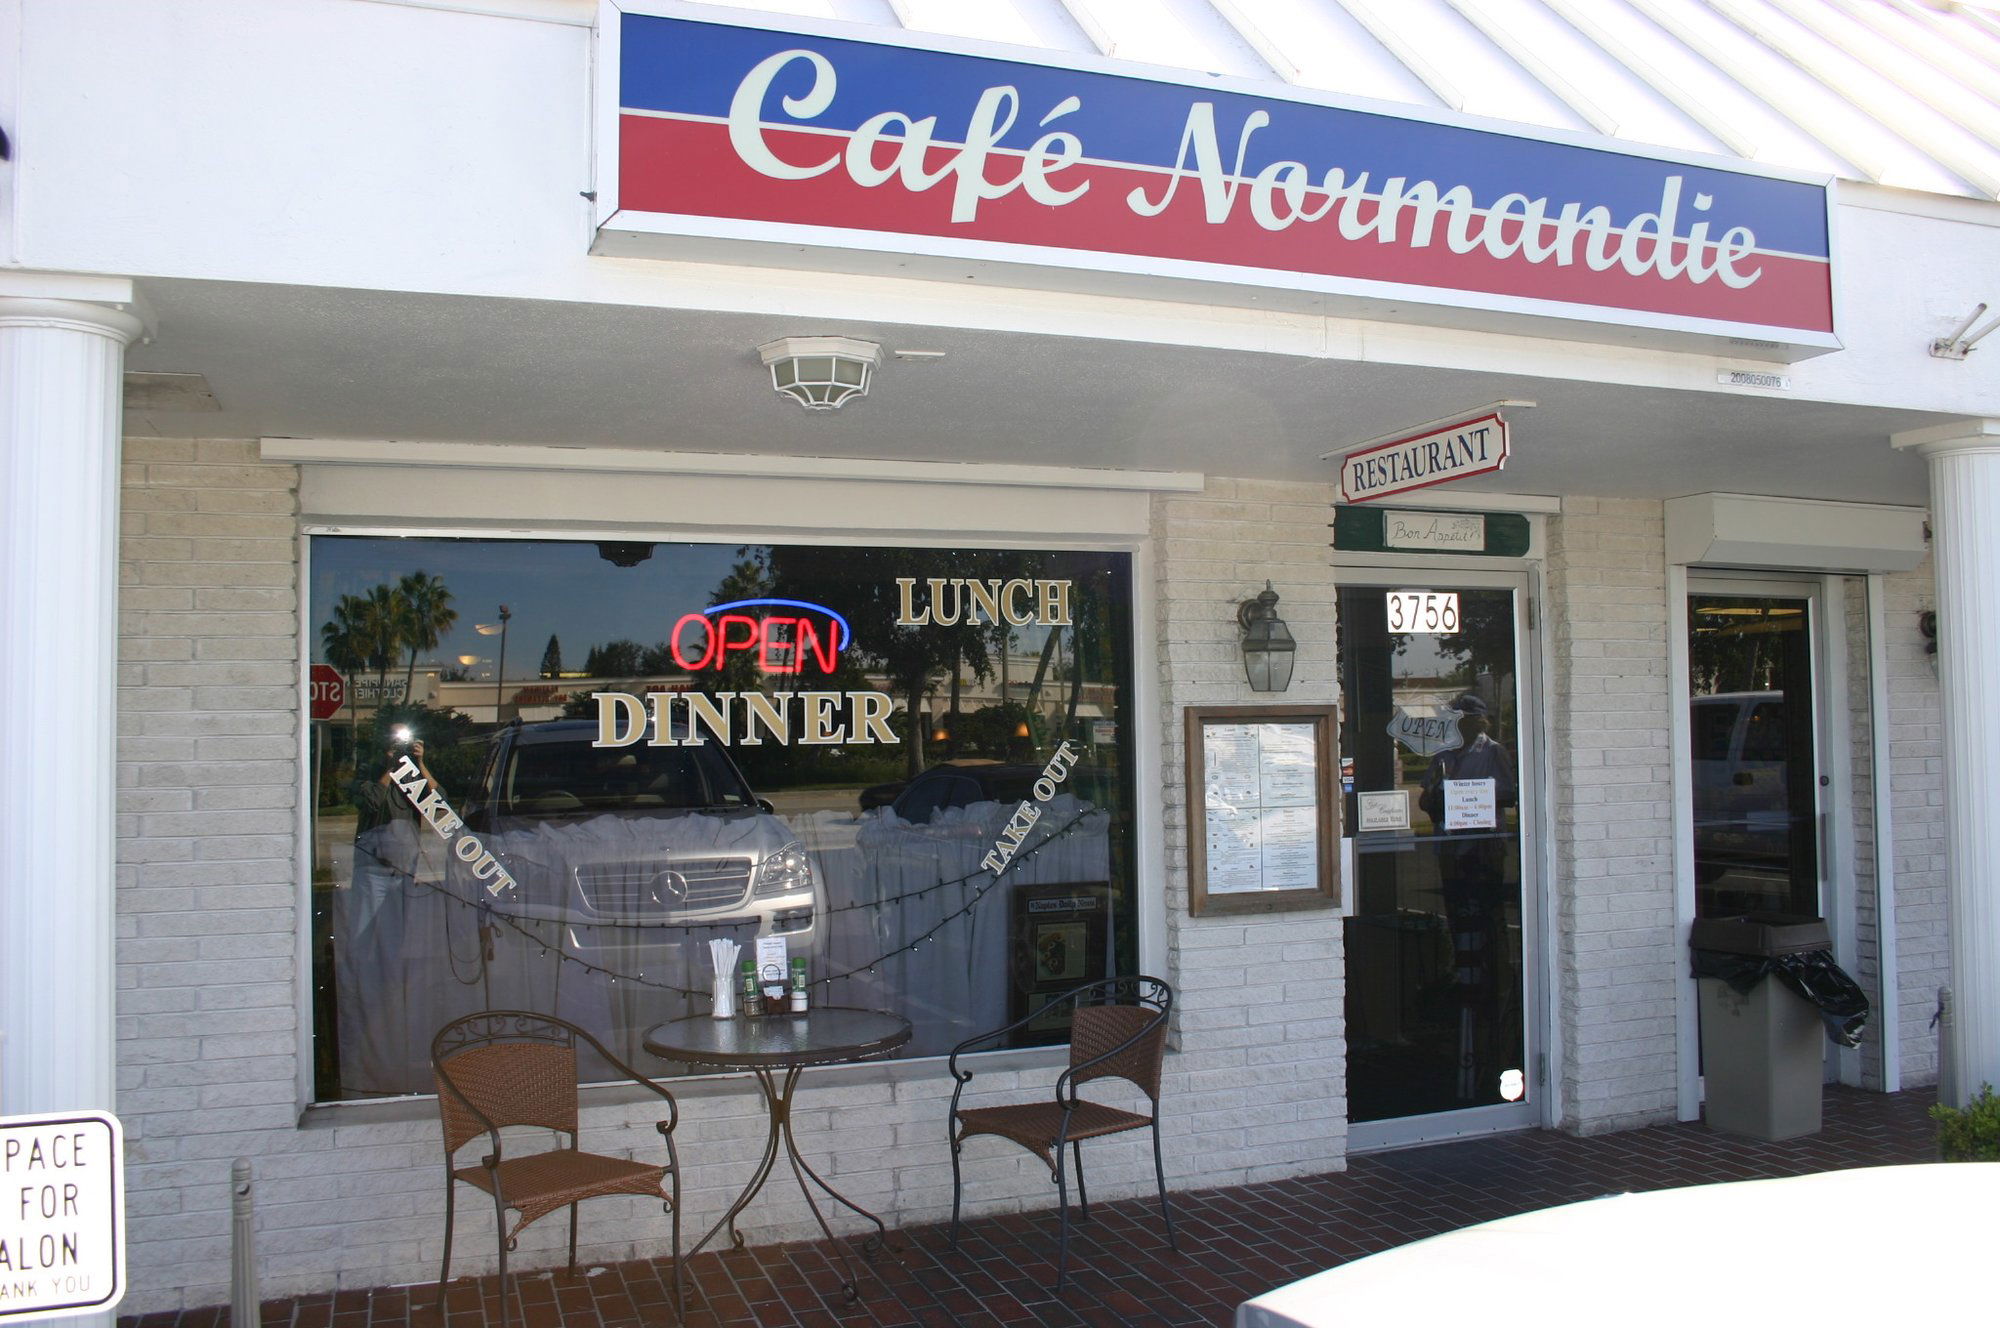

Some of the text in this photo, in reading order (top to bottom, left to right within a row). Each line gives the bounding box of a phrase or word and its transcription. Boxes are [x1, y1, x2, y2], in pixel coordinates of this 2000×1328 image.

[728, 49, 1762, 289] Café Normandie
[1353, 427, 1490, 492] RESTAURANT
[1392, 520, 1421, 540] Bon
[896, 577, 1073, 626] LUNCH
[1390, 594, 1457, 631] 3756
[670, 612, 839, 674] OPEN
[591, 690, 900, 748] DINNER
[1401, 715, 1452, 743] OPEN
[389, 755, 517, 897] TAKE OUT
[981, 740, 1079, 875] TAKE OUT
[6, 1133, 86, 1172] PACE
[21, 1183, 78, 1221] FOR
[0, 1232, 78, 1271] ALON
[52, 1275, 90, 1294] YOU
